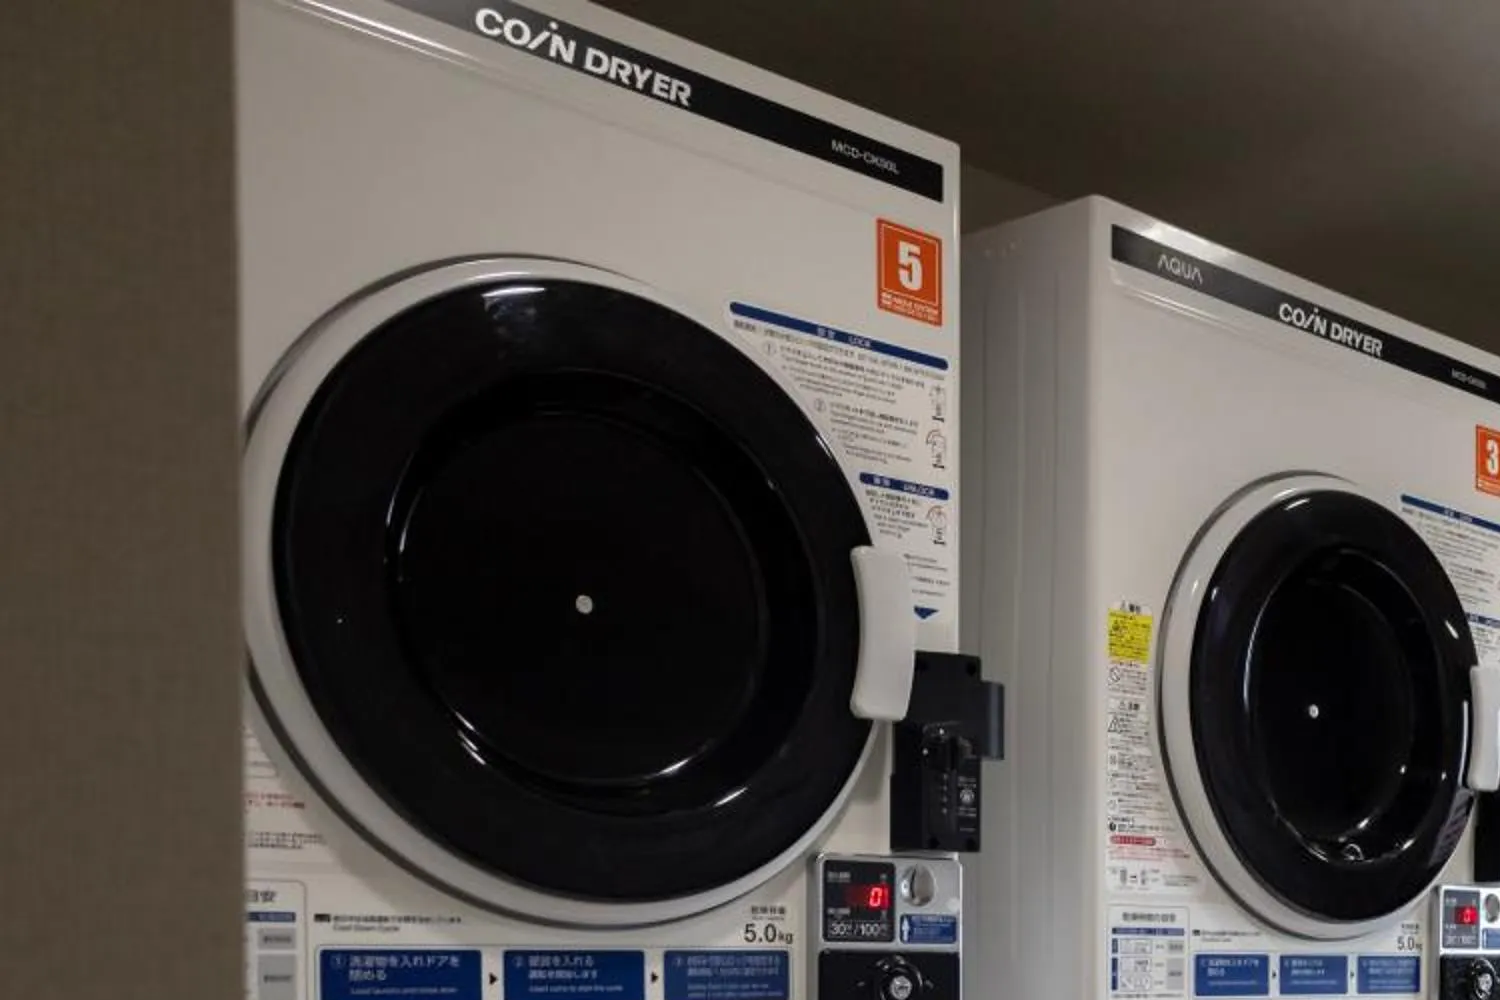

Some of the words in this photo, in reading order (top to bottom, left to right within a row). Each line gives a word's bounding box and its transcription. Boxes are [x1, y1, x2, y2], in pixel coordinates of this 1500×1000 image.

[475, 8, 577, 64] COIN
[584, 47, 693, 107] DRYER
[898, 241, 923, 291] 5
[1157, 254, 1203, 284] AQUA
[1279, 302, 1328, 336] COIN
[1329, 322, 1383, 357] DRYER
[1485, 439, 1500, 476] 3
[869, 887, 883, 907] 0
[743, 922, 794, 945] 5.0kg
